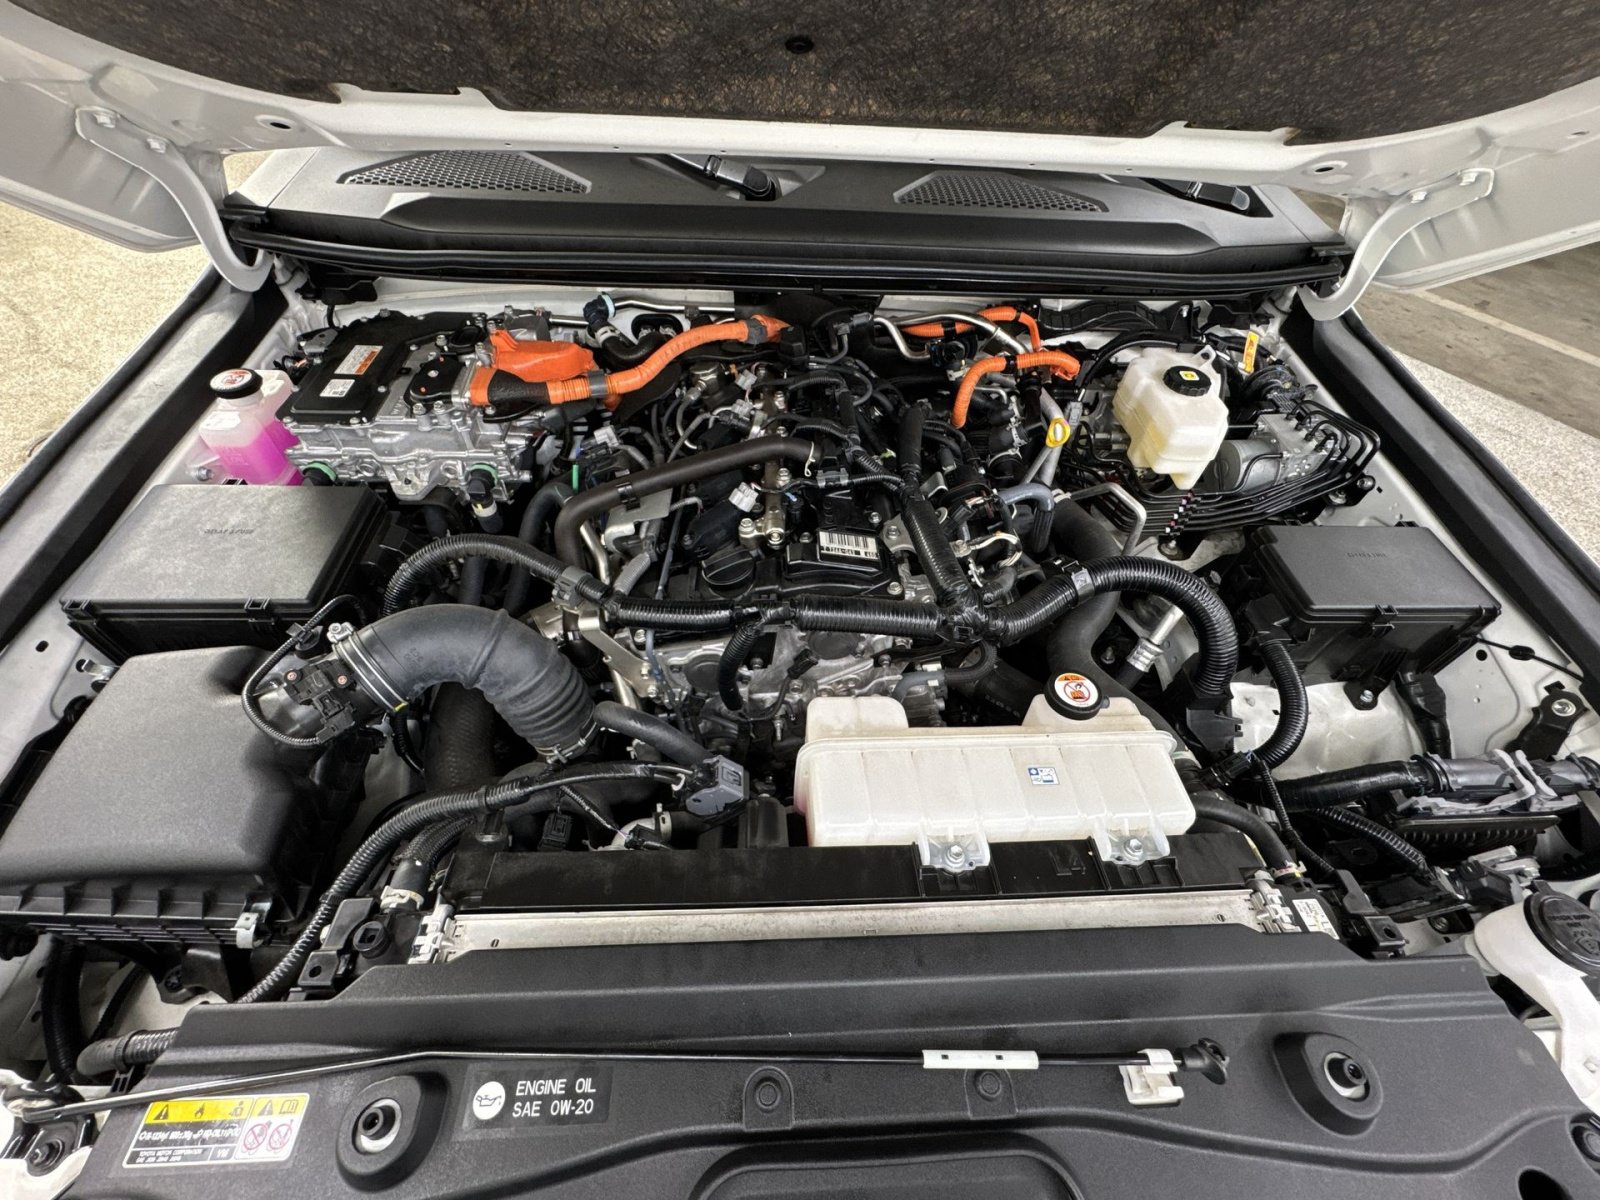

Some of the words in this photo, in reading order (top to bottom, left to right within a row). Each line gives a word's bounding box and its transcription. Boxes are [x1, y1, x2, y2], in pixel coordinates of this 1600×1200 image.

[515, 1079, 567, 1096] ENGINE
[575, 1077, 597, 1094] OIL
[512, 1101, 542, 1118] SAE
[550, 1099, 594, 1116] 0W-20
